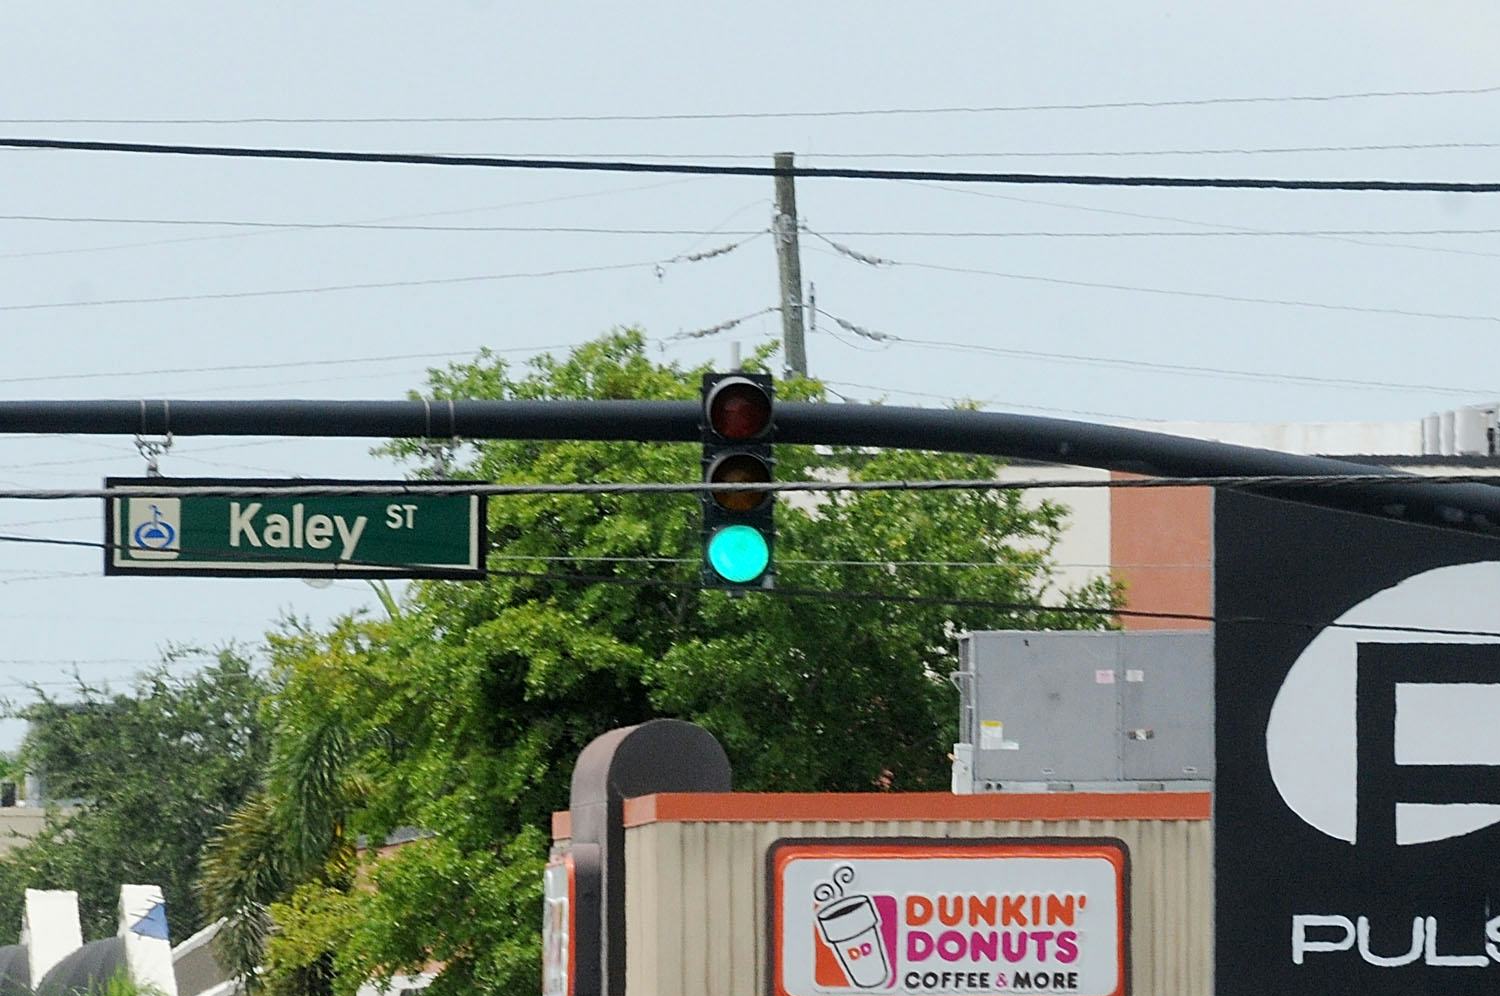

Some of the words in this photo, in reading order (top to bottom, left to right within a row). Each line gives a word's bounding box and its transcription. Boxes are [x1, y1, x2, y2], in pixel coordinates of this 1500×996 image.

[229, 502, 368, 561] Kaley
[385, 504, 418, 530] ST
[905, 894, 1087, 927] DUNKIN'
[905, 930, 1079, 963] DONUTS
[904, 972, 990, 989] COFFEE
[1012, 972, 1078, 989] MORE
